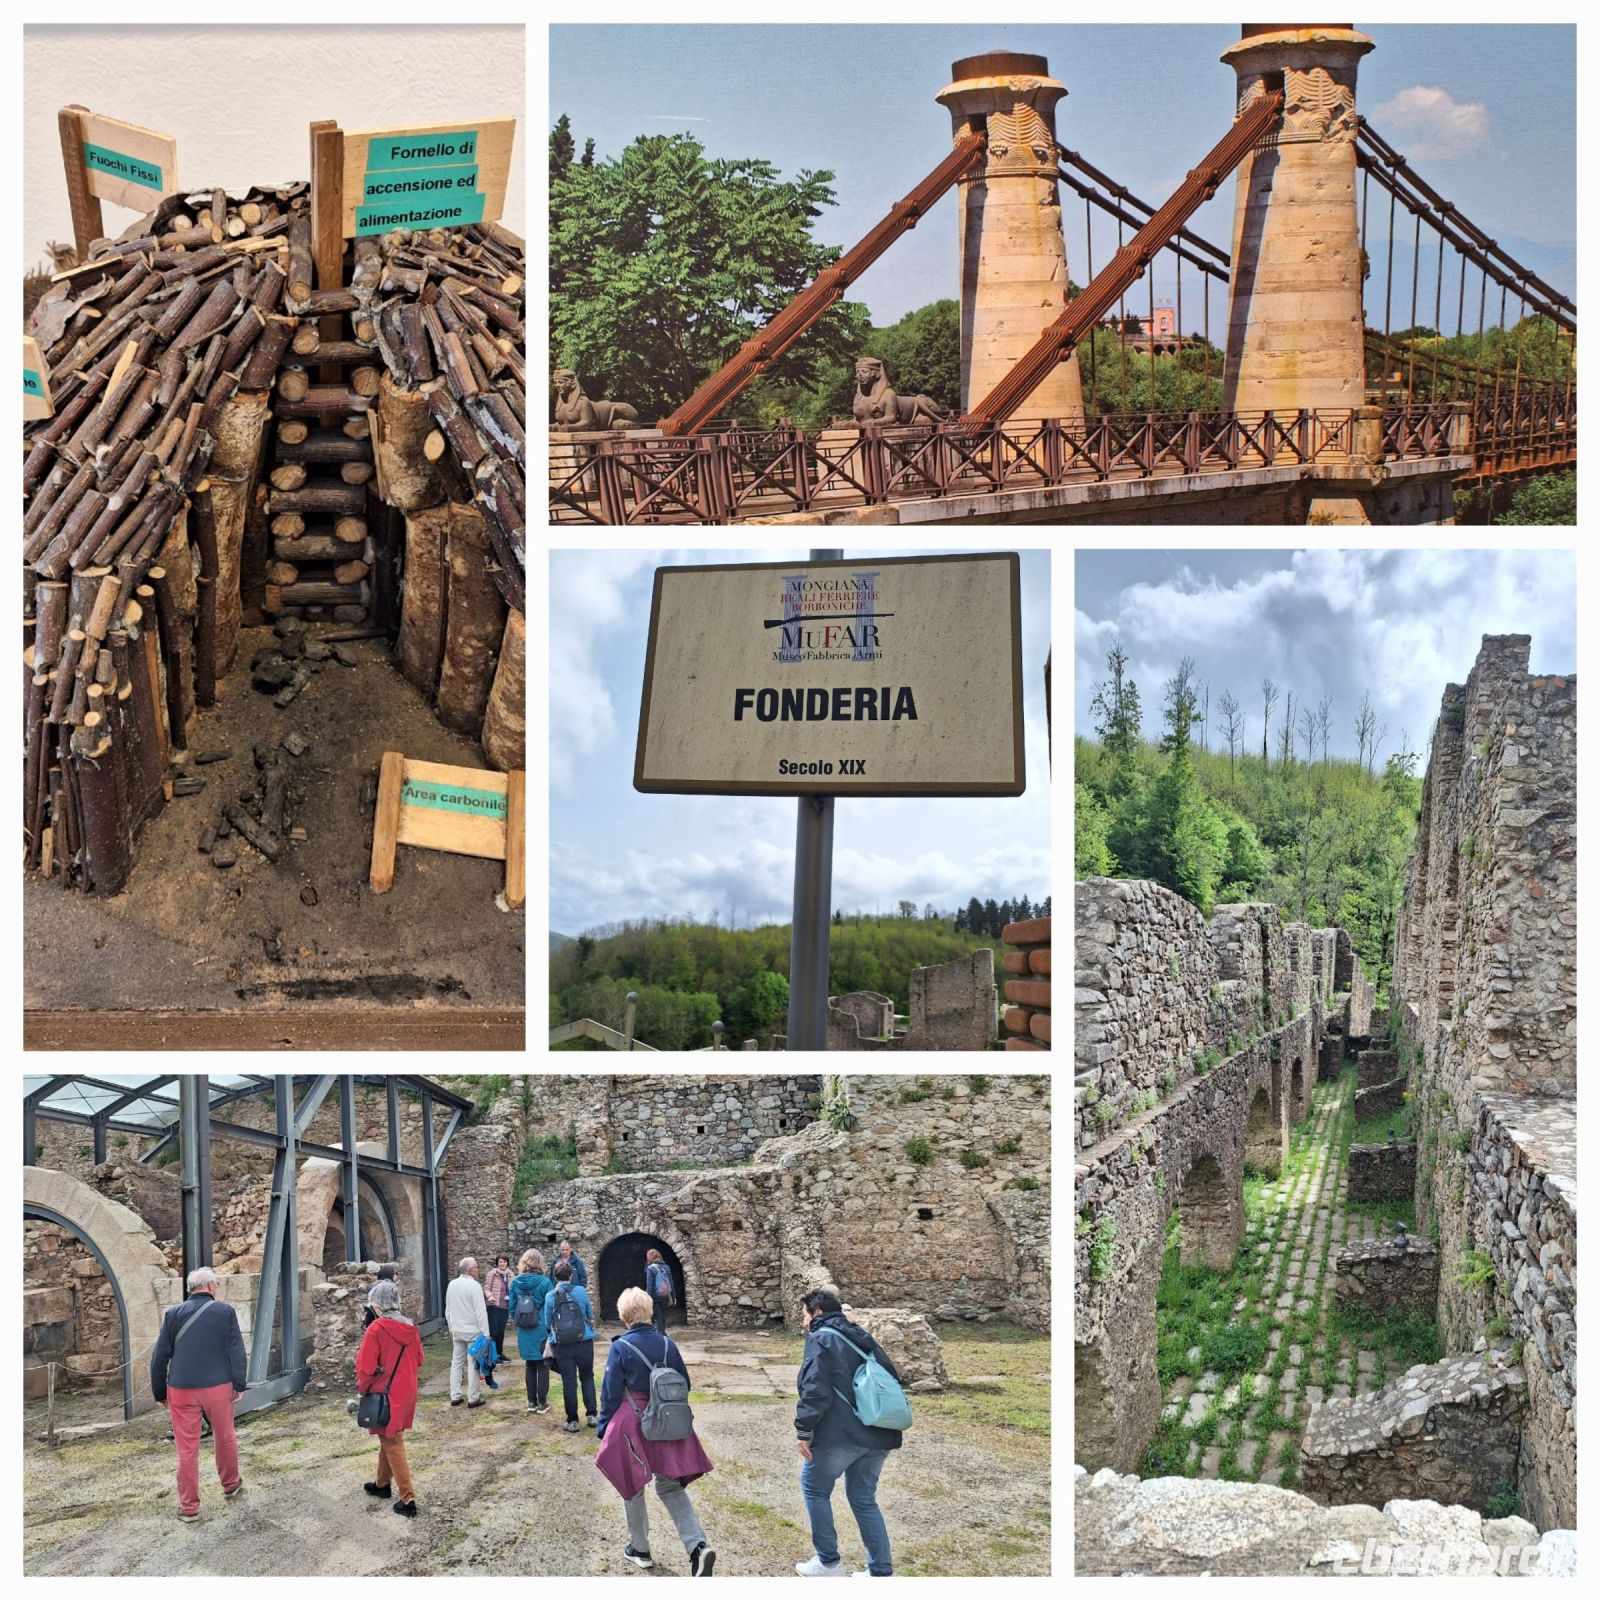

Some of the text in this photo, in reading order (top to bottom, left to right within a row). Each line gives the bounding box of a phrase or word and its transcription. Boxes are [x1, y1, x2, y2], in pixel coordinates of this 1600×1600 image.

[391, 142, 474, 160] Fornello di
[89, 151, 158, 183] Fuochi Fissi
[366, 174, 476, 195] accensione ed
[359, 207, 463, 227] alimentazione
[791, 579, 869, 592] MONGIANA
[781, 591, 879, 603] REALI FERRIERE
[792, 601, 867, 612] BORBONICHE
[734, 686, 918, 722] FONDERIA
[779, 759, 866, 775] Secolo XIX
[404, 786, 506, 811] Area carbonile
